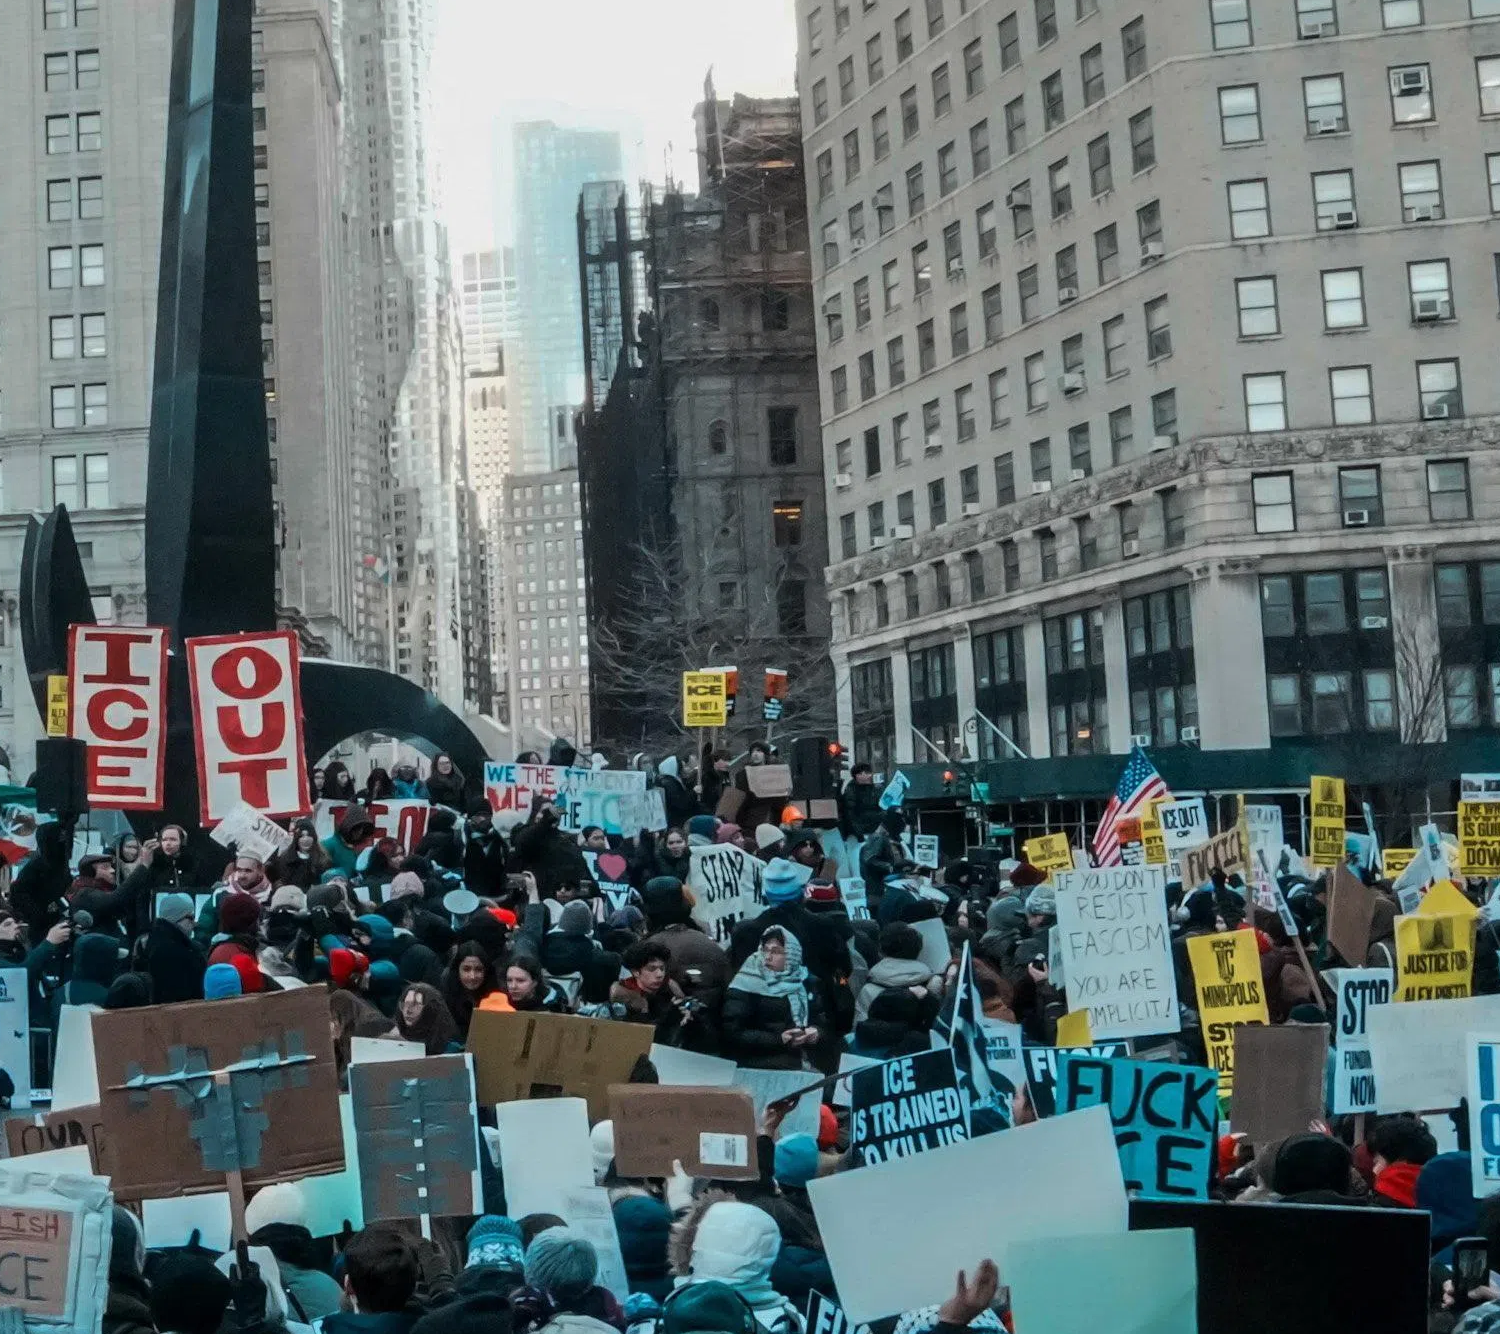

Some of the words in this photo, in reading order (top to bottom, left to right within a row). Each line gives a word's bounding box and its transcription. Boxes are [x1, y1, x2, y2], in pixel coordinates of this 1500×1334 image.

[687, 685, 722, 696] ICE
[83, 633, 153, 797] ICE
[211, 646, 288, 809] OUT
[486, 764, 515, 784] WE
[521, 766, 554, 784] THE
[1180, 806, 1199, 828] OUT
[1464, 822, 1475, 836] IS
[1057, 873, 1073, 891] IF
[1082, 871, 1109, 891] YOU
[1077, 892, 1148, 921] RESIST
[1070, 923, 1167, 959] FASCISM
[1404, 952, 1449, 975] JUSTICE
[1450, 950, 1468, 971] FOR
[1073, 975, 1108, 999] YOU
[1118, 968, 1157, 990] ARE
[1092, 998, 1171, 1027] MPLICIT!
[1208, 1020, 1264, 1042] ST
[882, 1058, 916, 1095] ICE
[1067, 1059, 1217, 1131] FUCK
[852, 1112, 867, 1144] IS
[869, 1087, 960, 1136] TRAINED
[884, 1133, 930, 1163] KILL
[937, 1123, 965, 1147] US
[1117, 1131, 1206, 1195] CE
